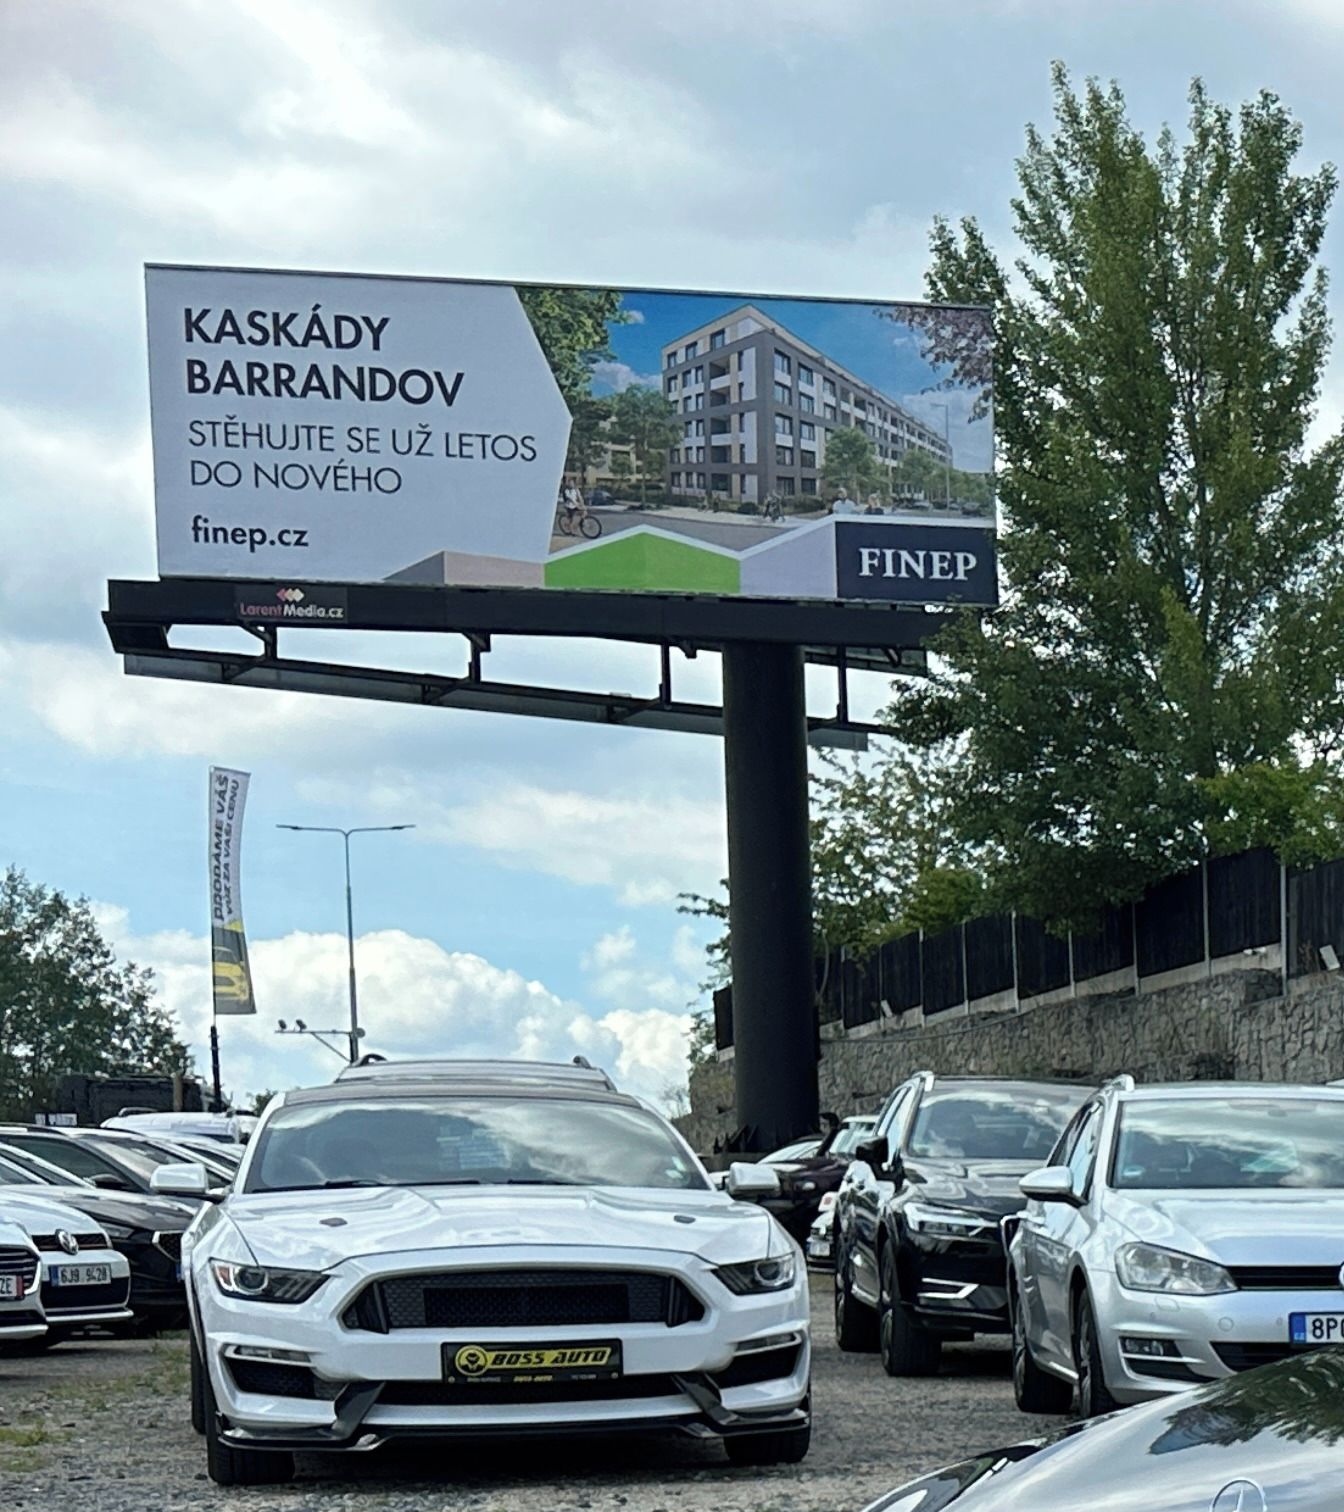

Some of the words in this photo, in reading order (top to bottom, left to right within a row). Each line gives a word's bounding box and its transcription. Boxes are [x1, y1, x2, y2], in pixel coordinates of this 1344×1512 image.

[184, 303, 390, 351] KASKÁDY
[186, 359, 465, 407] BARRANDOV
[188, 414, 335, 452] STĚHUJTE
[346, 427, 381, 454] SE
[391, 422, 434, 457] UŽ
[445, 432, 537, 462] LETOS
[190, 460, 242, 488] DO
[254, 458, 403, 494] NOVÉHO
[192, 515, 309, 553] finep.cz
[858, 547, 977, 580] FINEP
[491, 1352, 545, 1366] BOSS
[551, 1349, 607, 1364] AUTO
